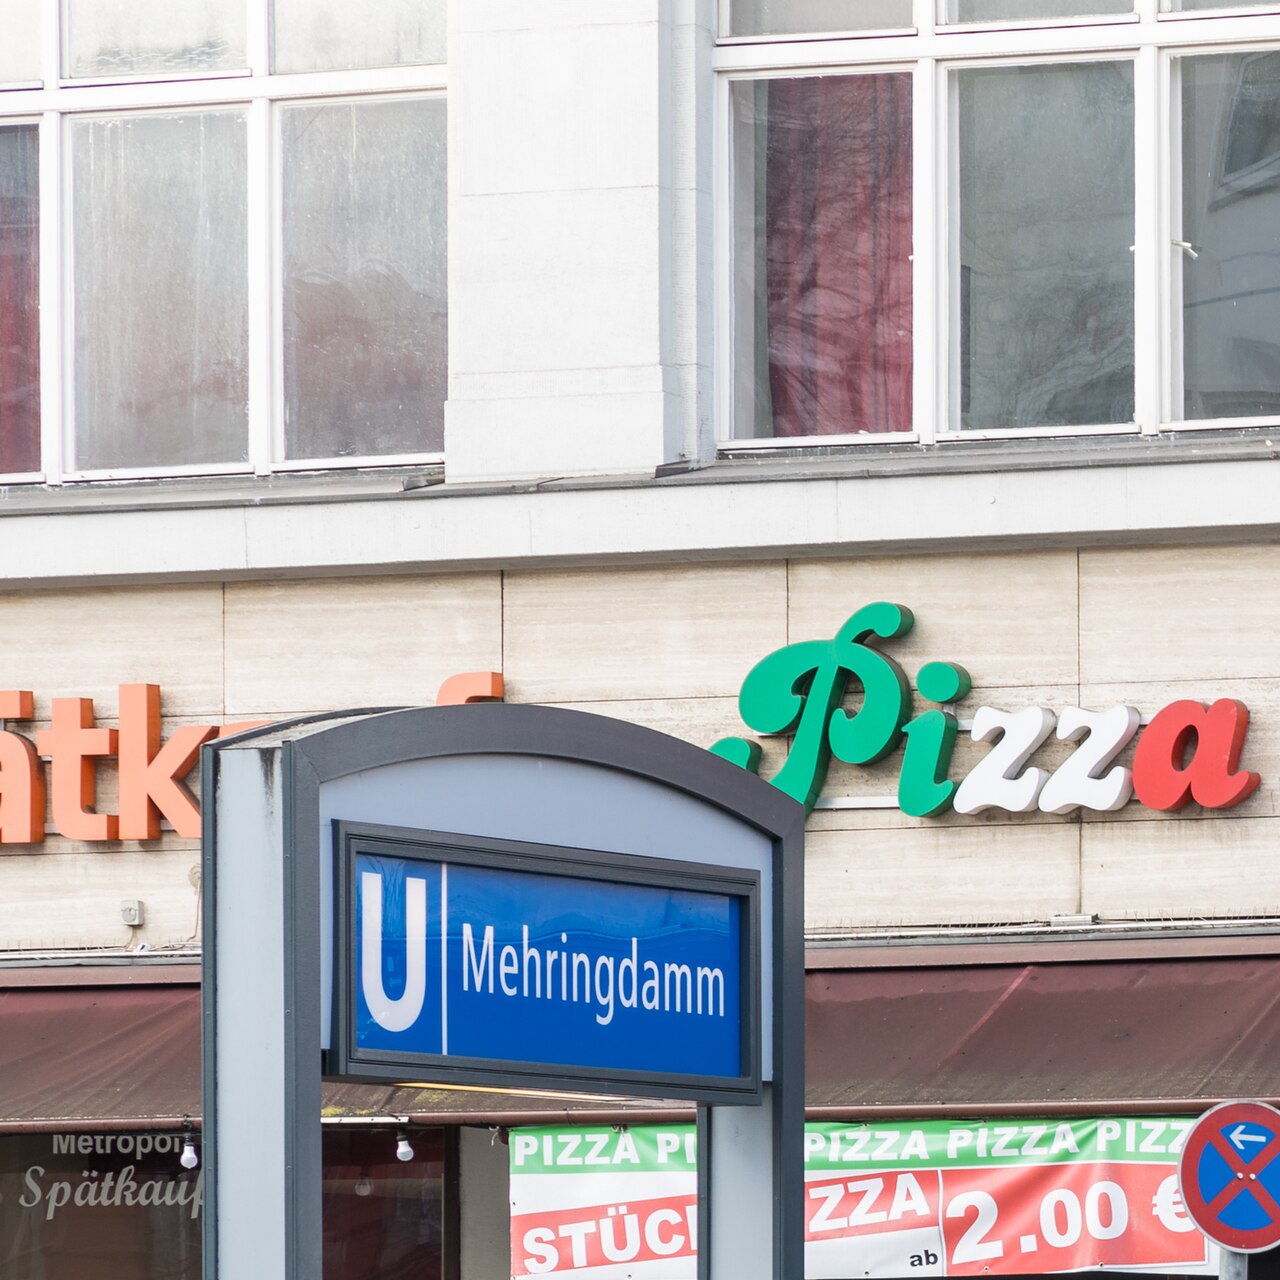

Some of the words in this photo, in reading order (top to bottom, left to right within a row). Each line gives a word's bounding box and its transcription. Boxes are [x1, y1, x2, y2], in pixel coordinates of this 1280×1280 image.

[710, 602, 1261, 818] Pizza
[361, 872, 427, 1033] U
[462, 923, 726, 1026] Mehringdamm
[515, 1132, 641, 1166] PIZZA
[805, 1130, 930, 1161] PIZZA
[947, 1123, 1080, 1158] PIZZA
[1097, 1120, 1190, 1153] PIZZ
[807, 1172, 931, 1232] ZZA
[946, 1180, 1129, 1264] 2.00
[1152, 1177, 1198, 1233] €
[909, 1247, 939, 1267] ab
